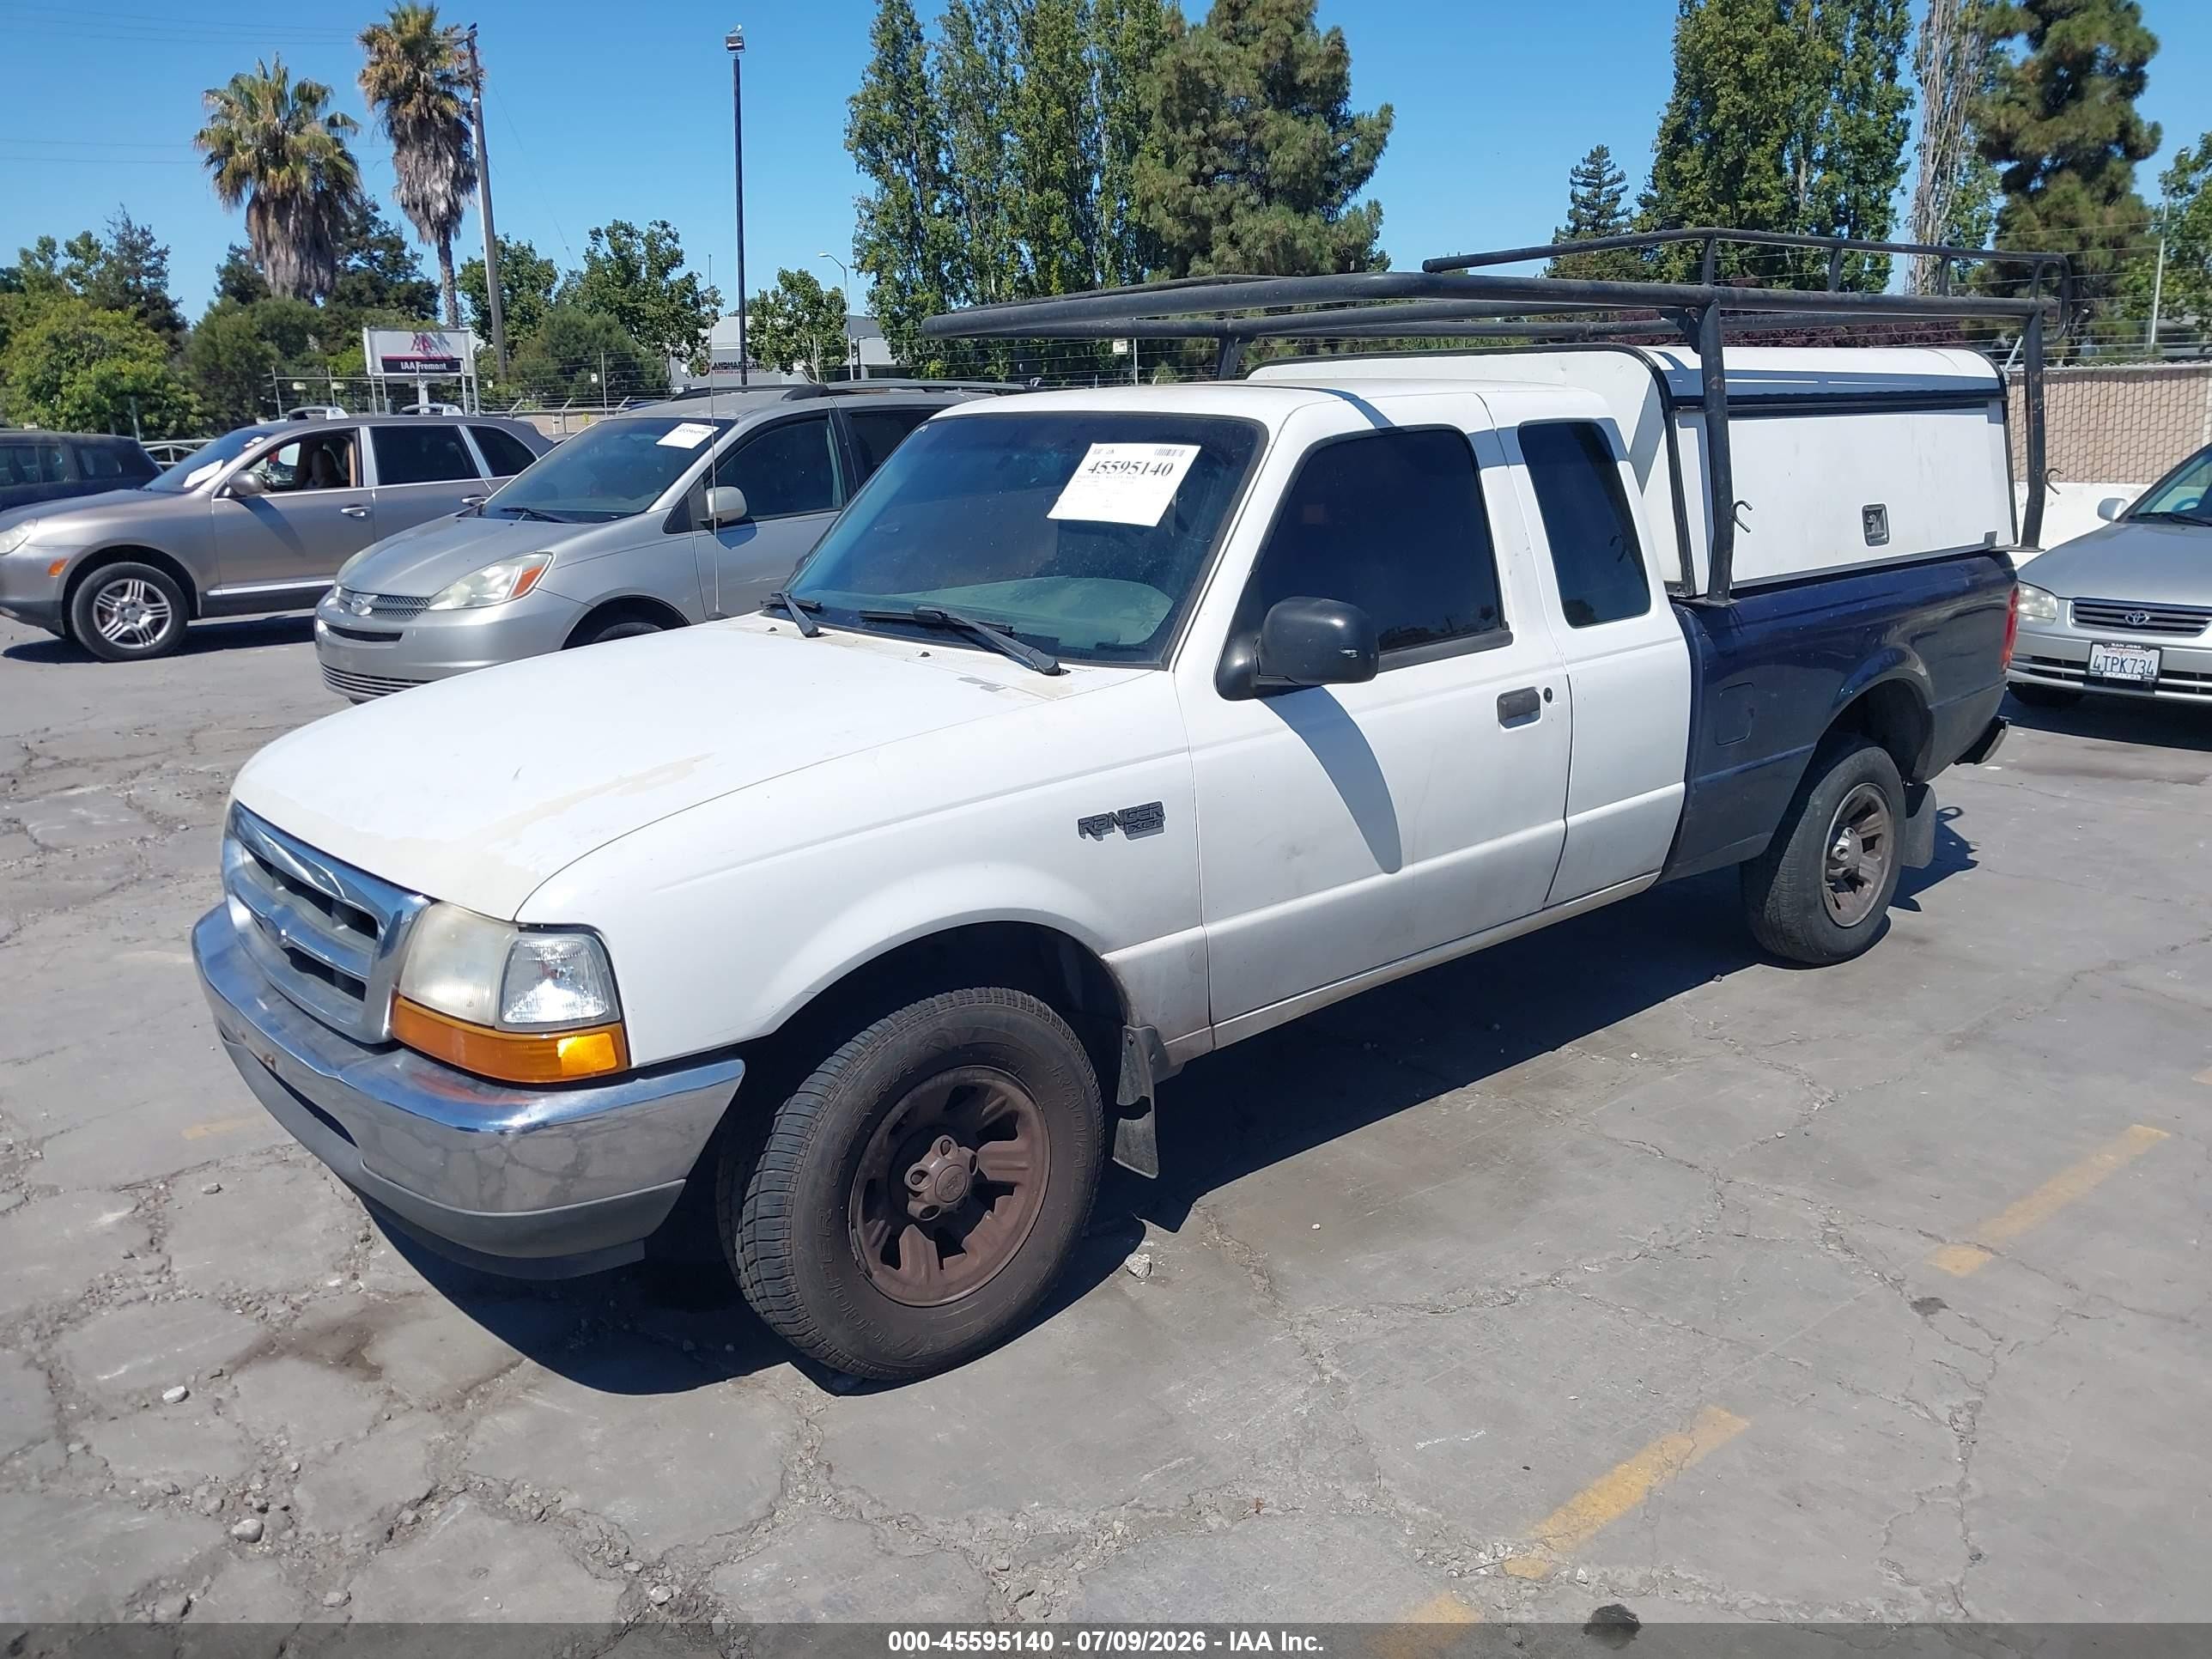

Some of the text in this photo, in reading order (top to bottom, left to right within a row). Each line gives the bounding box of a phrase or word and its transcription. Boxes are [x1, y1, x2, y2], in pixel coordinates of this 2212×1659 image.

[417, 362, 447, 370] Fremont
[1087, 459, 1174, 477] 45595140
[2093, 654, 2154, 676] 4TPK734
[1078, 801, 1165, 841] RANGER
